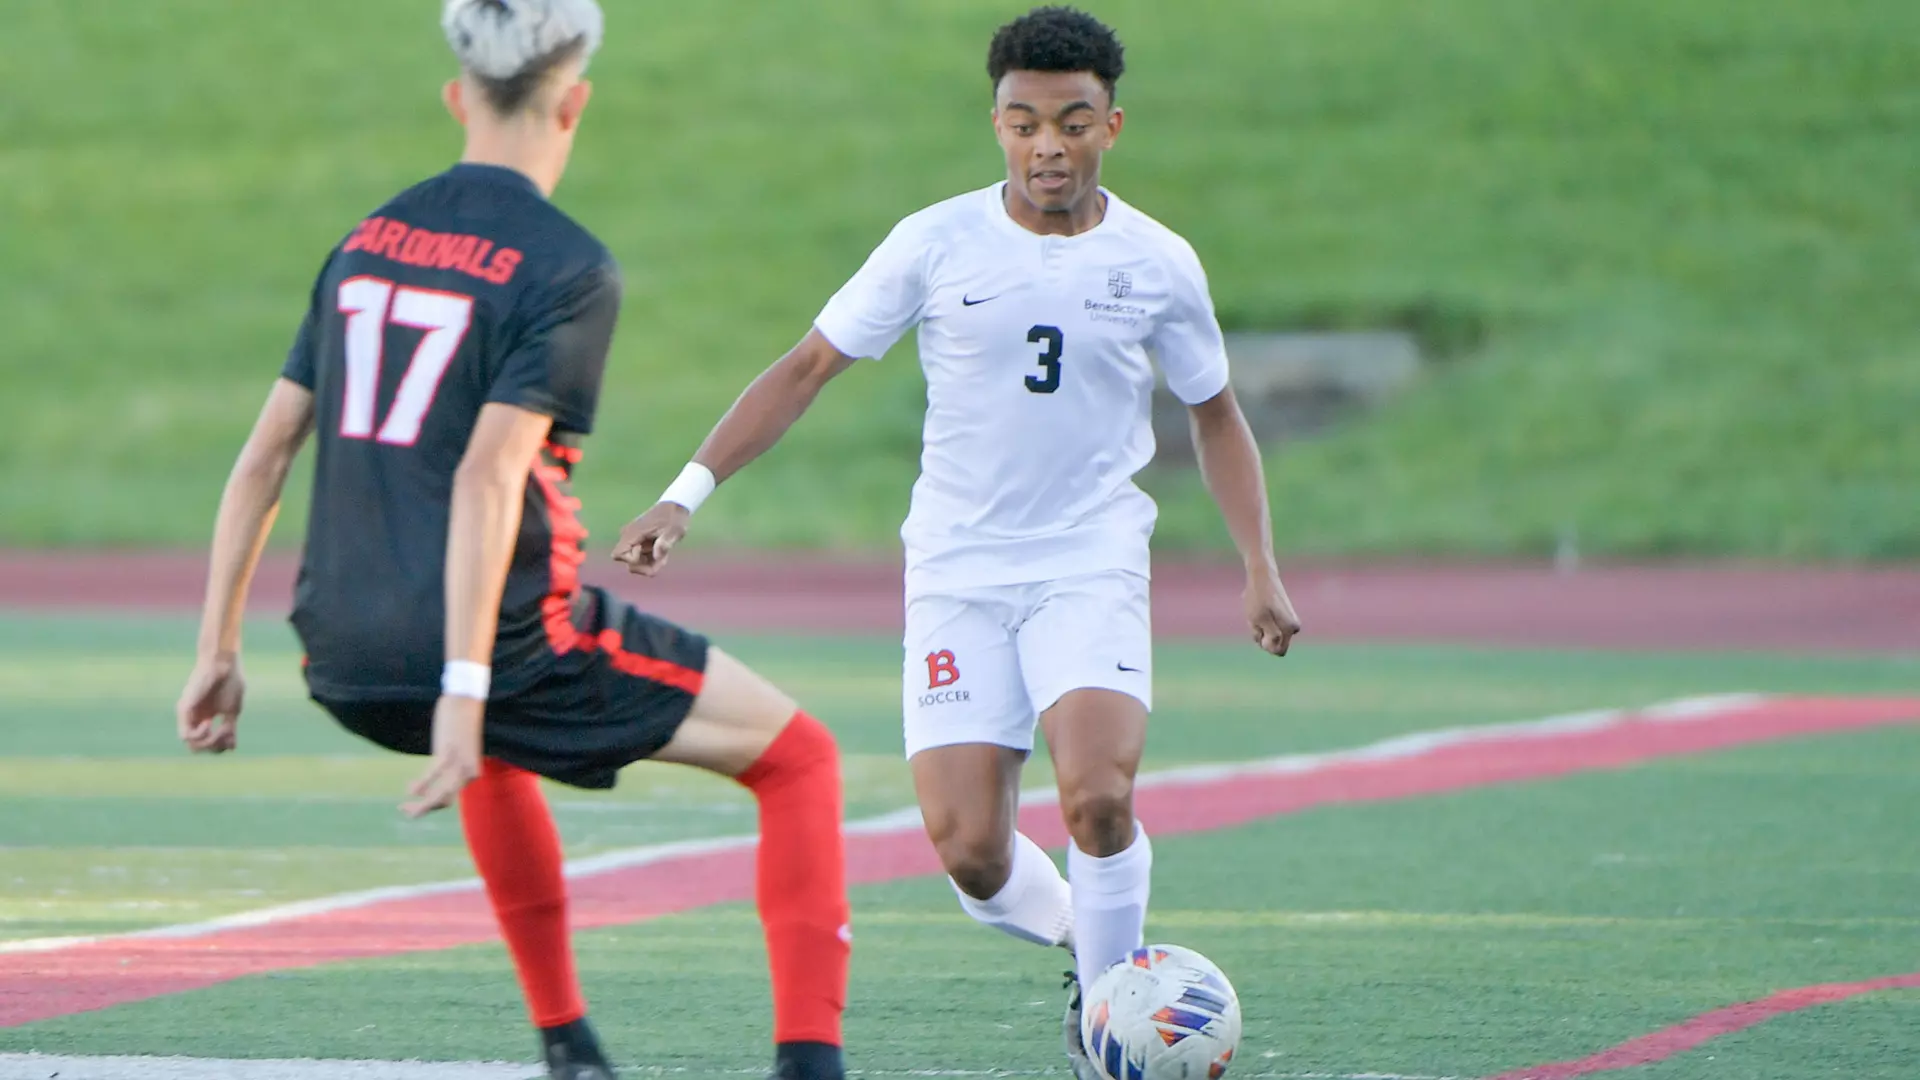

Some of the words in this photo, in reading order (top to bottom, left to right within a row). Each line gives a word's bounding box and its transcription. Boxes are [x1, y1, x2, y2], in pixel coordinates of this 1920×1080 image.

[1084, 299, 1146, 315] Benedictine
[338, 274, 475, 447] 17
[1024, 324, 1064, 393] 3
[925, 648, 960, 690] B
[918, 690, 971, 708] SOCCER
